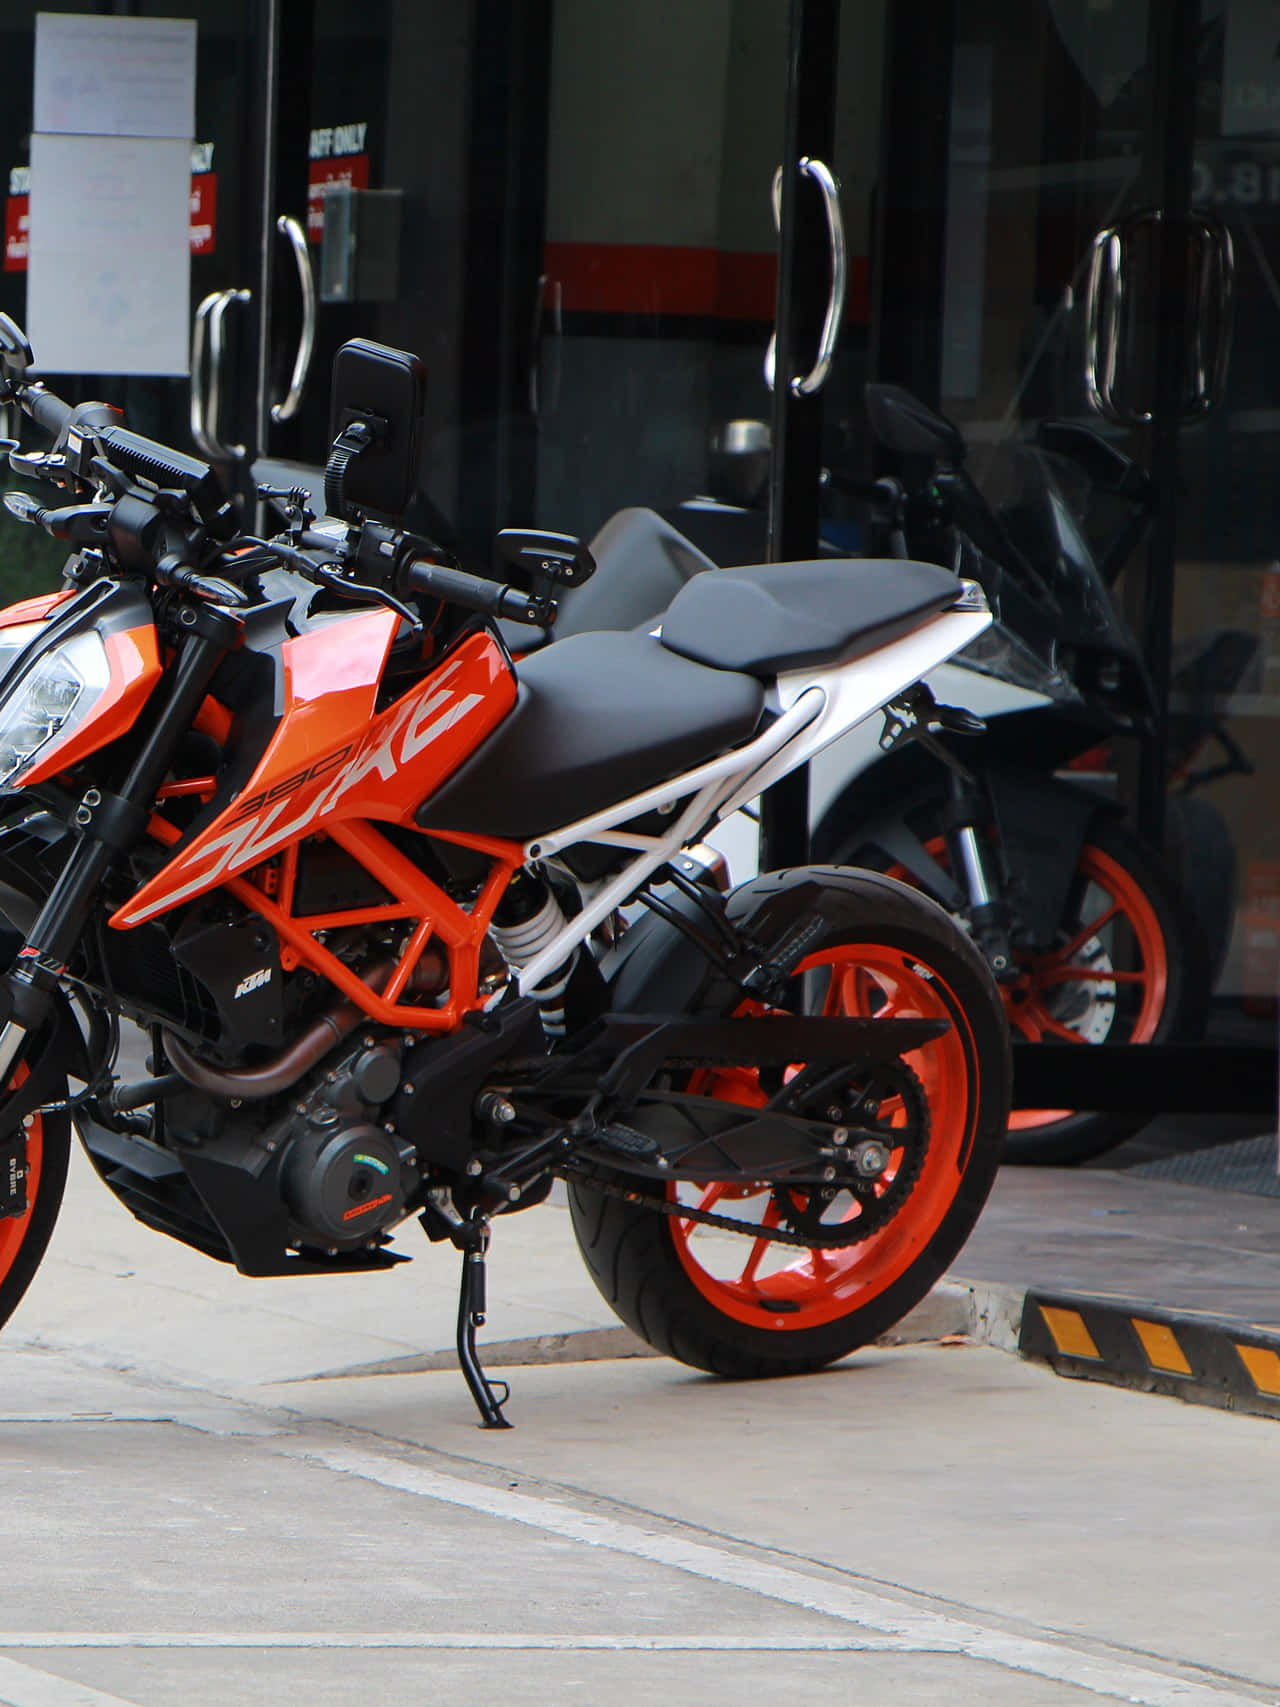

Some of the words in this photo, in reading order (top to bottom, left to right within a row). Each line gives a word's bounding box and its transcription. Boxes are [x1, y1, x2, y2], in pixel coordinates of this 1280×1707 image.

[333, 122, 368, 156] ONLY
[222, 744, 355, 828] 390
[233, 967, 273, 999] KTM
[9, 1157, 17, 1197] BYBRE
